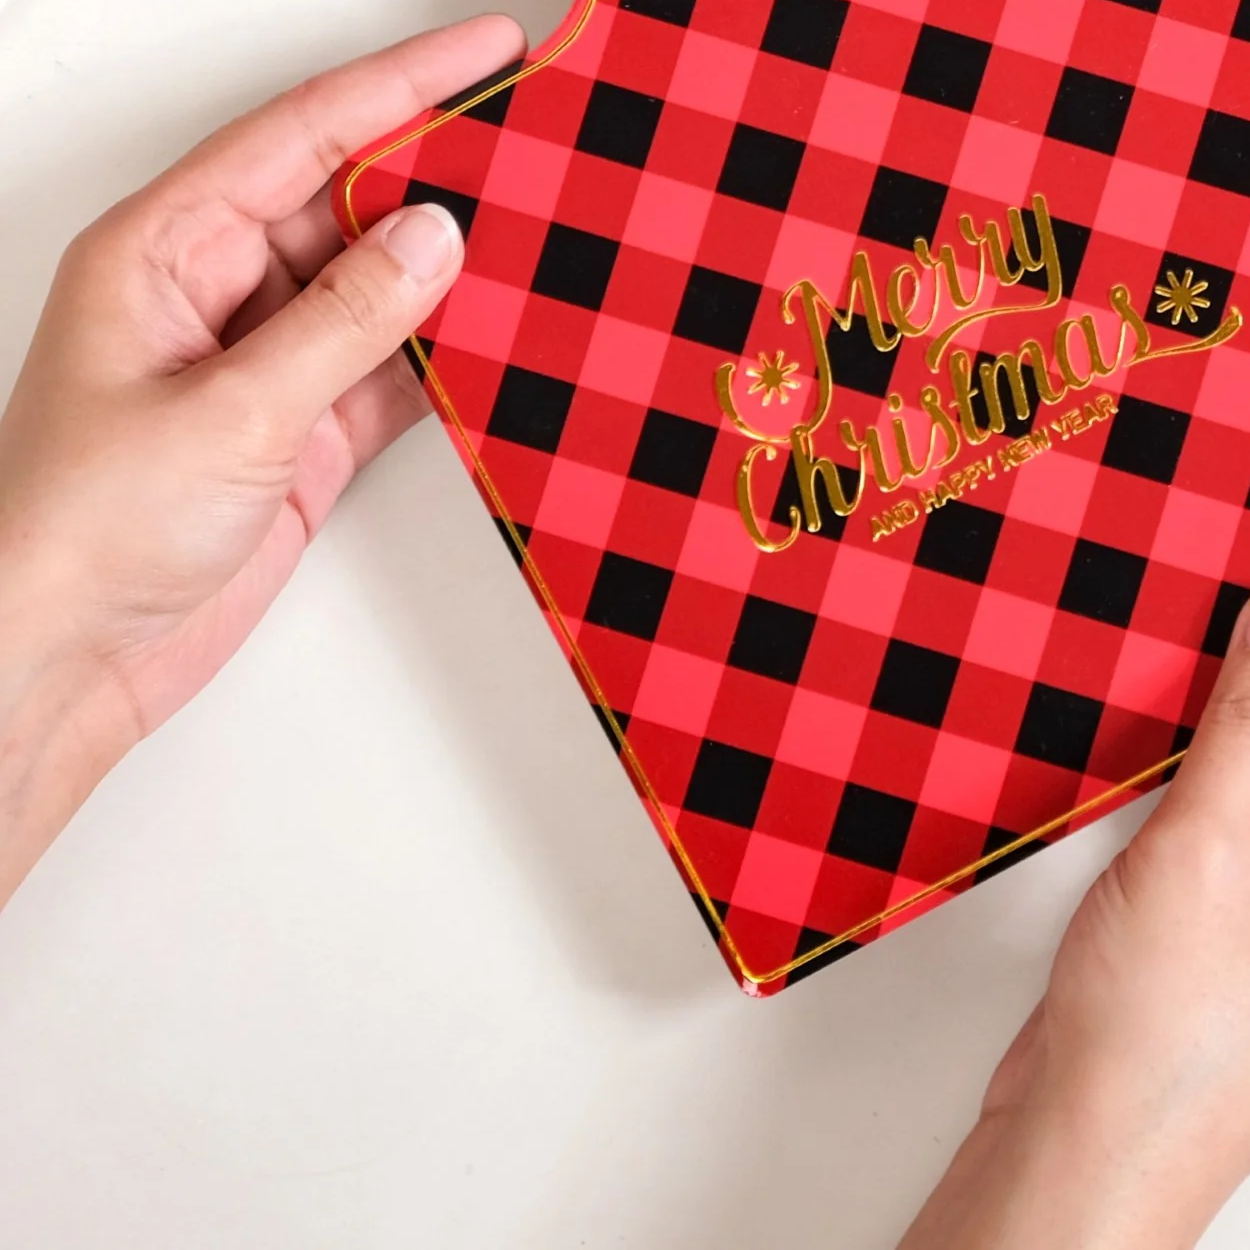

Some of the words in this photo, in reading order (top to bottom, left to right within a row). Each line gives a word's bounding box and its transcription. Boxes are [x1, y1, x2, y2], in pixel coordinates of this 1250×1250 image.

[715, 193, 1064, 444] Merry
[736, 283, 1243, 553] Christmas
[870, 500, 919, 543] AND
[919, 456, 996, 514] HAPPY
[997, 426, 1053, 472] NEW
[1051, 393, 1120, 441] YEAR
